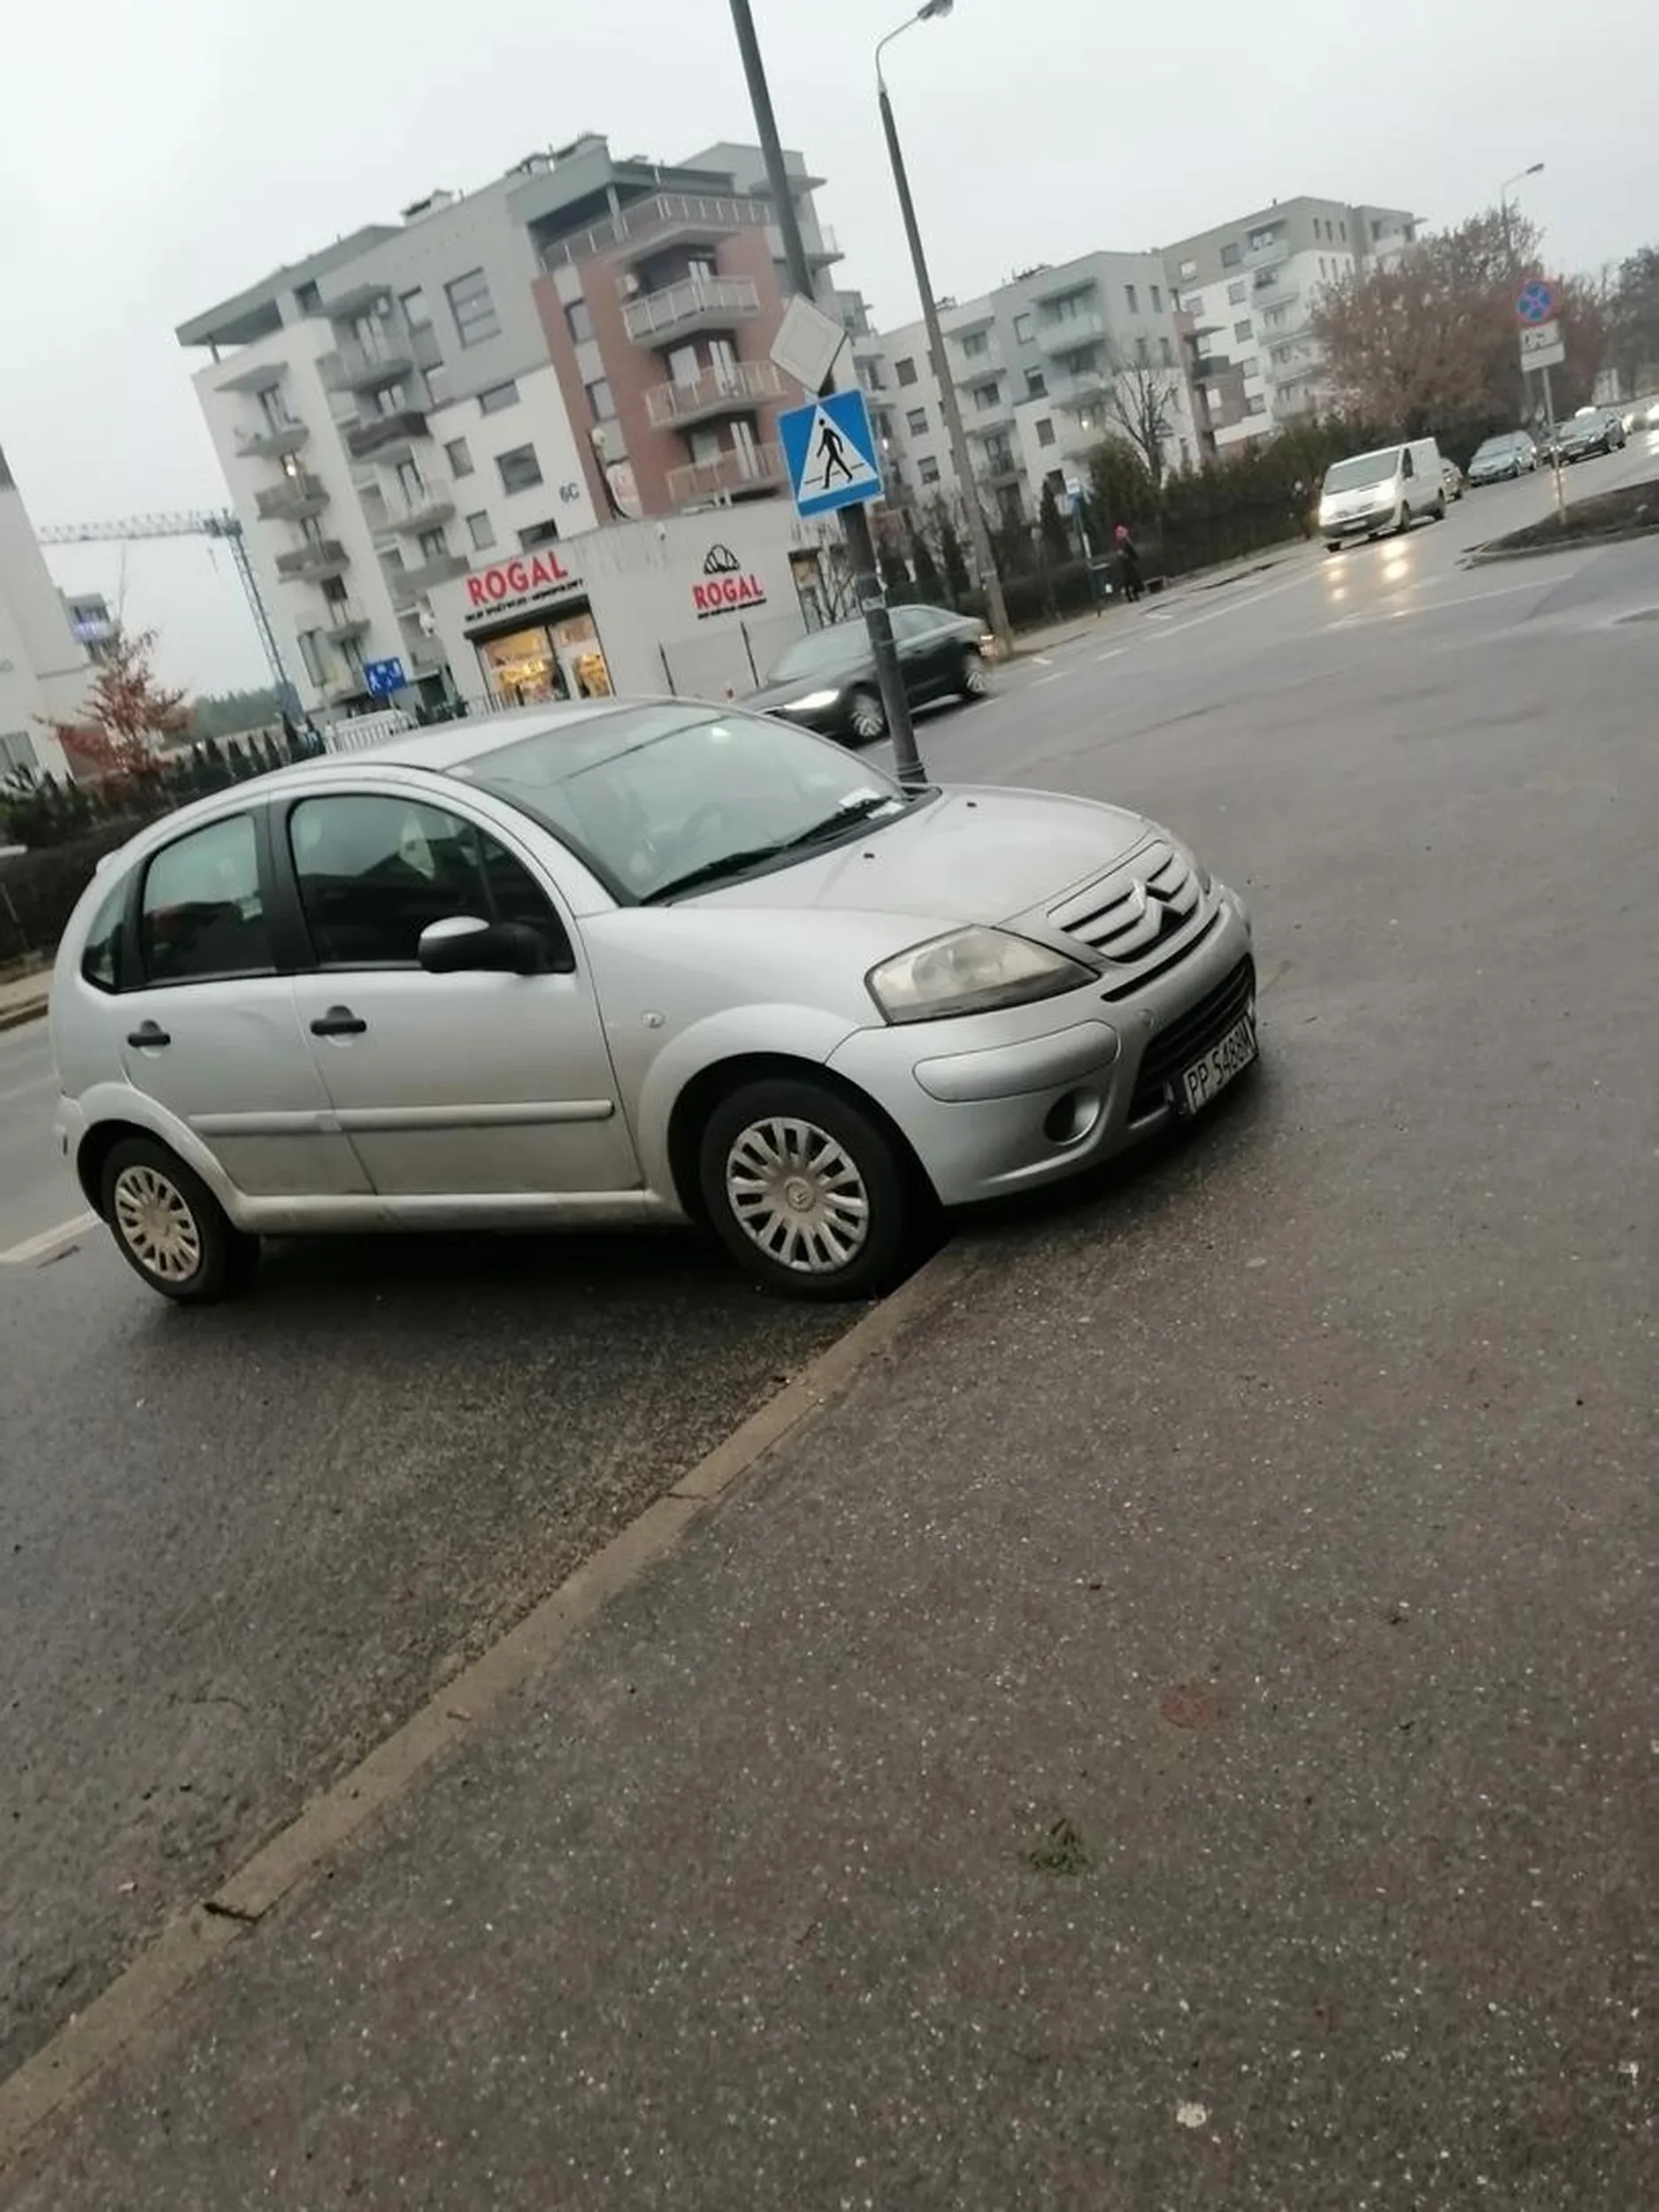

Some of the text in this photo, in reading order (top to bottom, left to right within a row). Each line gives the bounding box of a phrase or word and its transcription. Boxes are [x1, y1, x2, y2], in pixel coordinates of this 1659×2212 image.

[466, 550, 567, 607] ROGAL
[693, 573, 764, 609] ROGAL
[1187, 1062, 1209, 1111] PP
